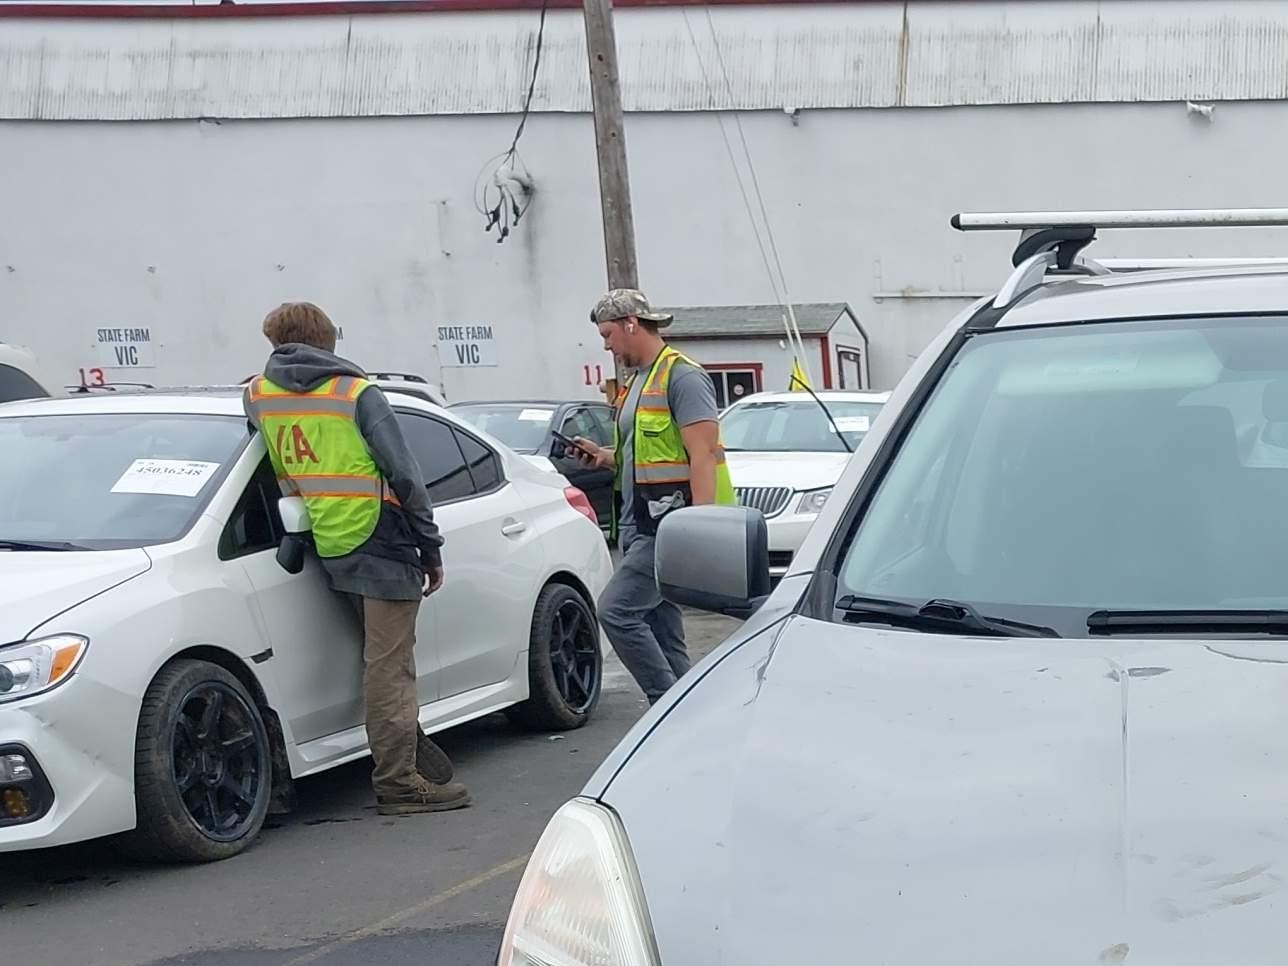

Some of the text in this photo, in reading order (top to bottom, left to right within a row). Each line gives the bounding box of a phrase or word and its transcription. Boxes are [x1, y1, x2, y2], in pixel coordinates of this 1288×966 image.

[97, 328, 151, 342] STATE FARM
[438, 326, 493, 341] STATE FARM
[114, 345, 139, 366] VIC
[455, 344, 480, 364] VIC
[79, 368, 105, 387] 13
